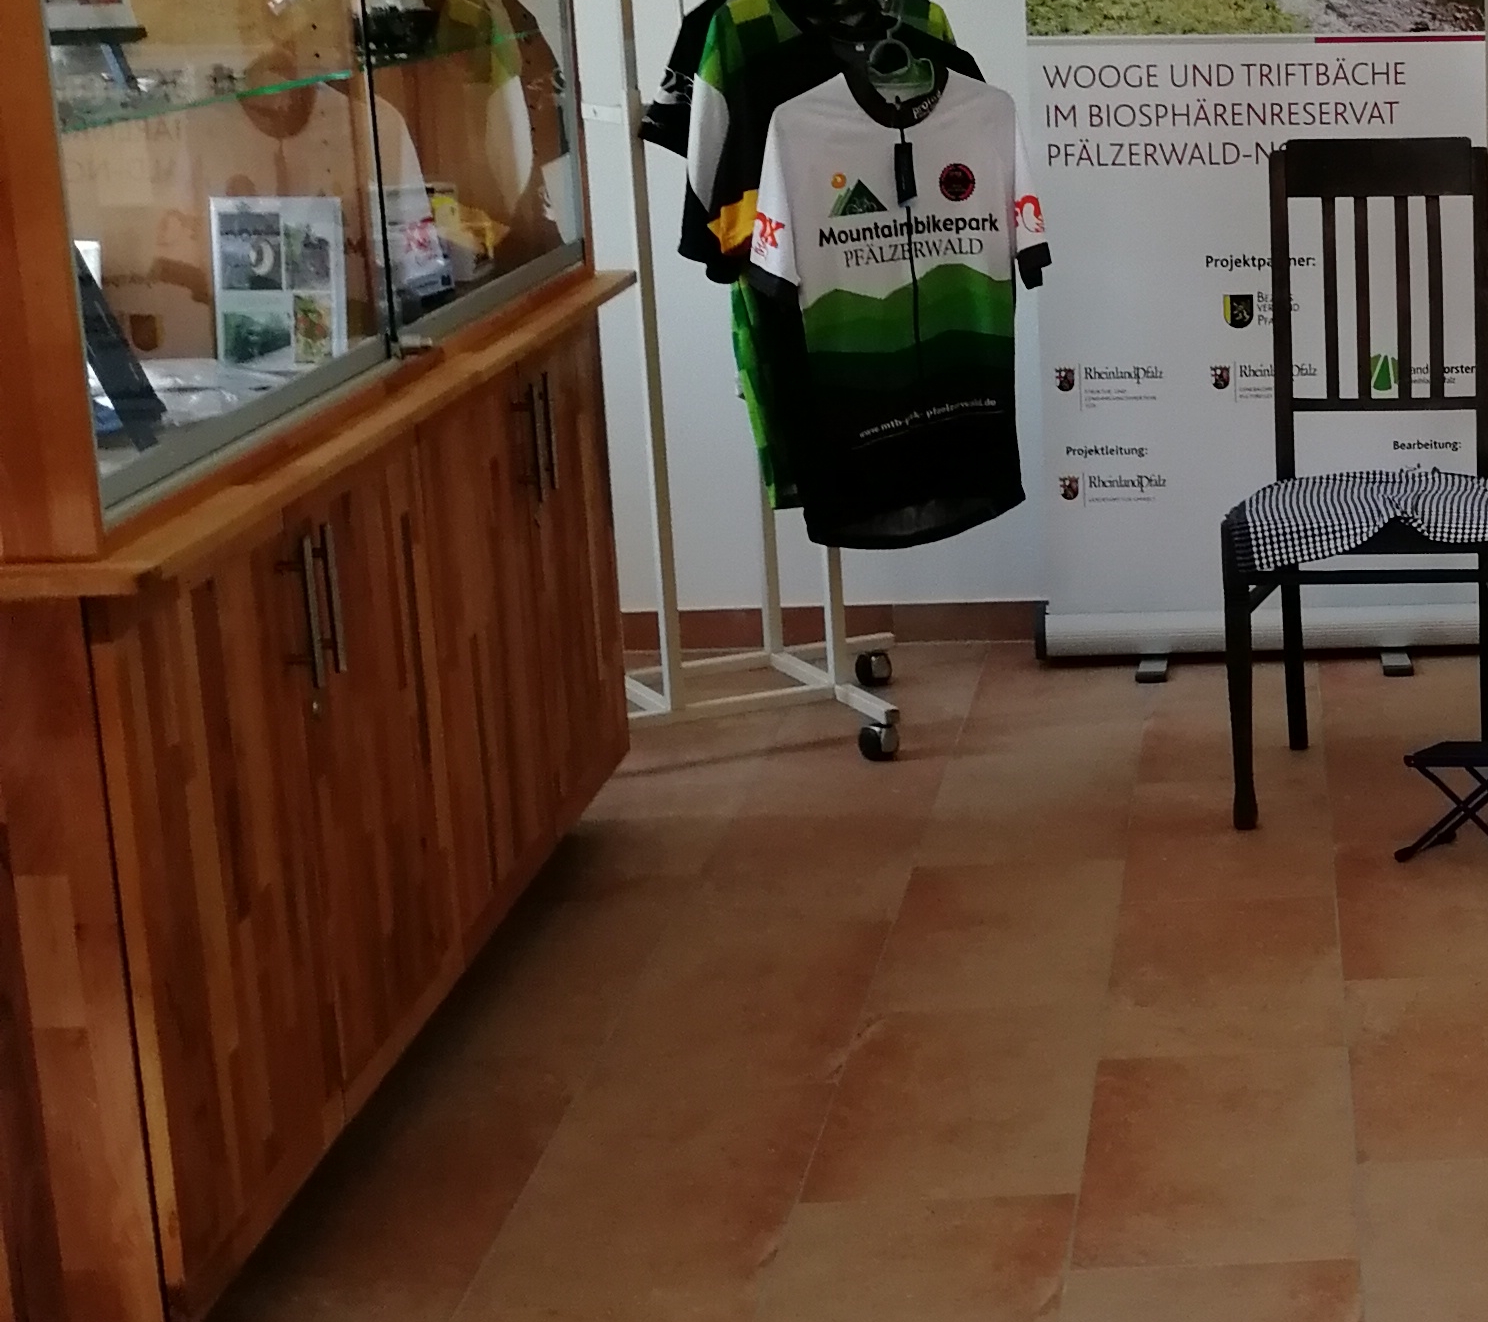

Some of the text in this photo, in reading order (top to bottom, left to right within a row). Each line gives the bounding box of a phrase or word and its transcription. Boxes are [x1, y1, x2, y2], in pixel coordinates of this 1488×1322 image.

[1043, 58, 1407, 89] WOOGE UND TRIFTBÄCHE
[1045, 99, 1400, 127] IM BIOSPHÄRENRESERVAT
[1048, 140, 1289, 167] PFÄLZERWALD-N
[818, 213, 1000, 247] Mountainbikepark
[844, 237, 984, 268] PFÄLZERWALD
[1206, 254, 1316, 271] Projektpaner:
[1065, 444, 1148, 458] Projektleitung:
[1392, 439, 1462, 451] Bearbeitung:
